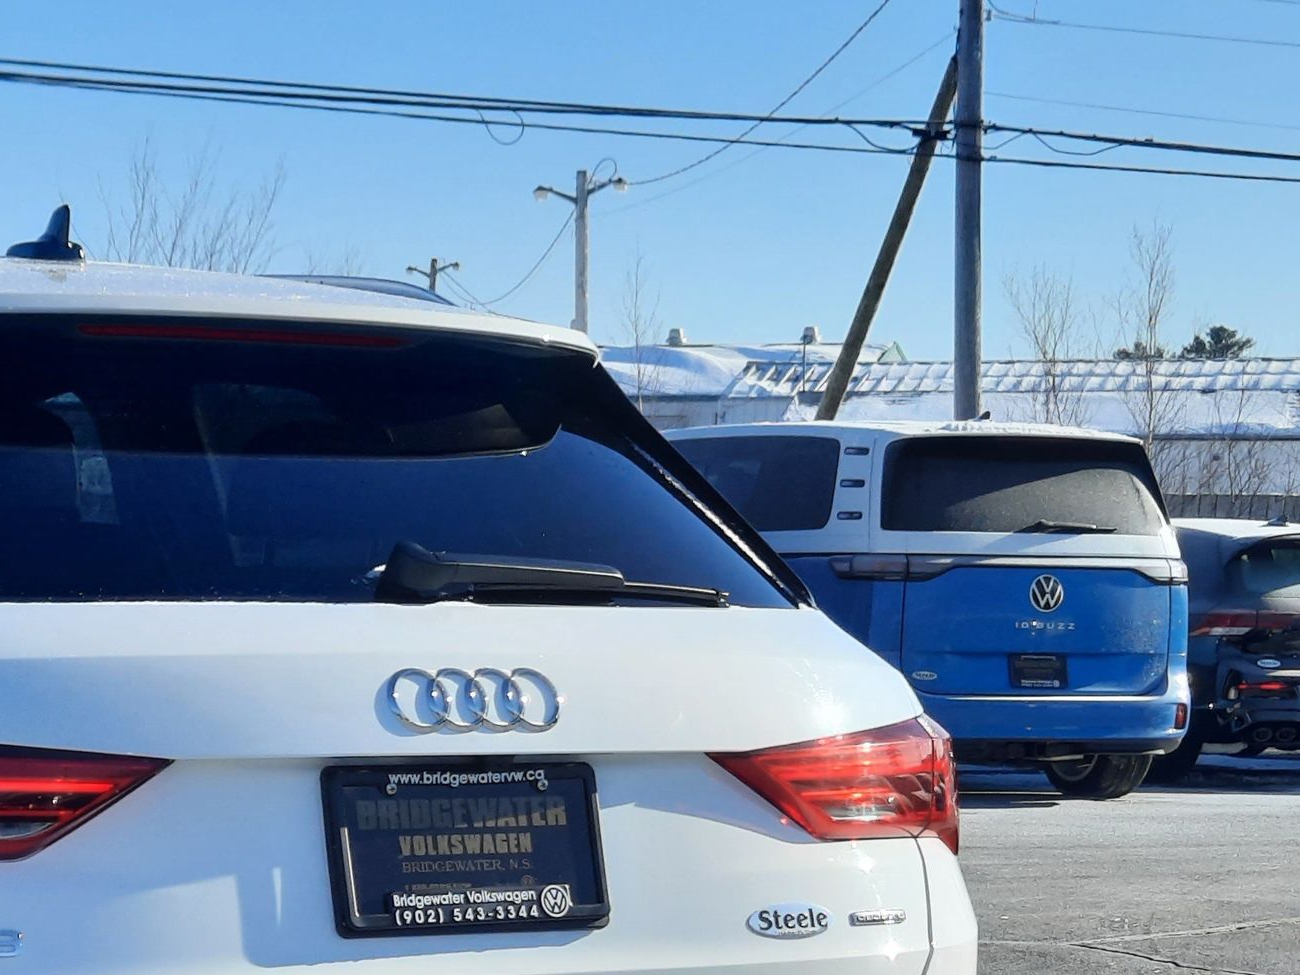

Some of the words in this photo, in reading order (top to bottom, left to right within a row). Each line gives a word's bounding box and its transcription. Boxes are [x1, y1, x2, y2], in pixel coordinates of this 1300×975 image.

[388, 769, 546, 788] www.bridgewatervw.ca
[355, 796, 568, 830] BRIDGEWATER
[398, 832, 533, 857] VOLKSWAGEN
[393, 893, 466, 909] Bridgewater
[466, 889, 537, 905] Volkswagen
[395, 908, 445, 926] (902)
[453, 904, 540, 923] 543-3344
[757, 908, 829, 931] Steele
